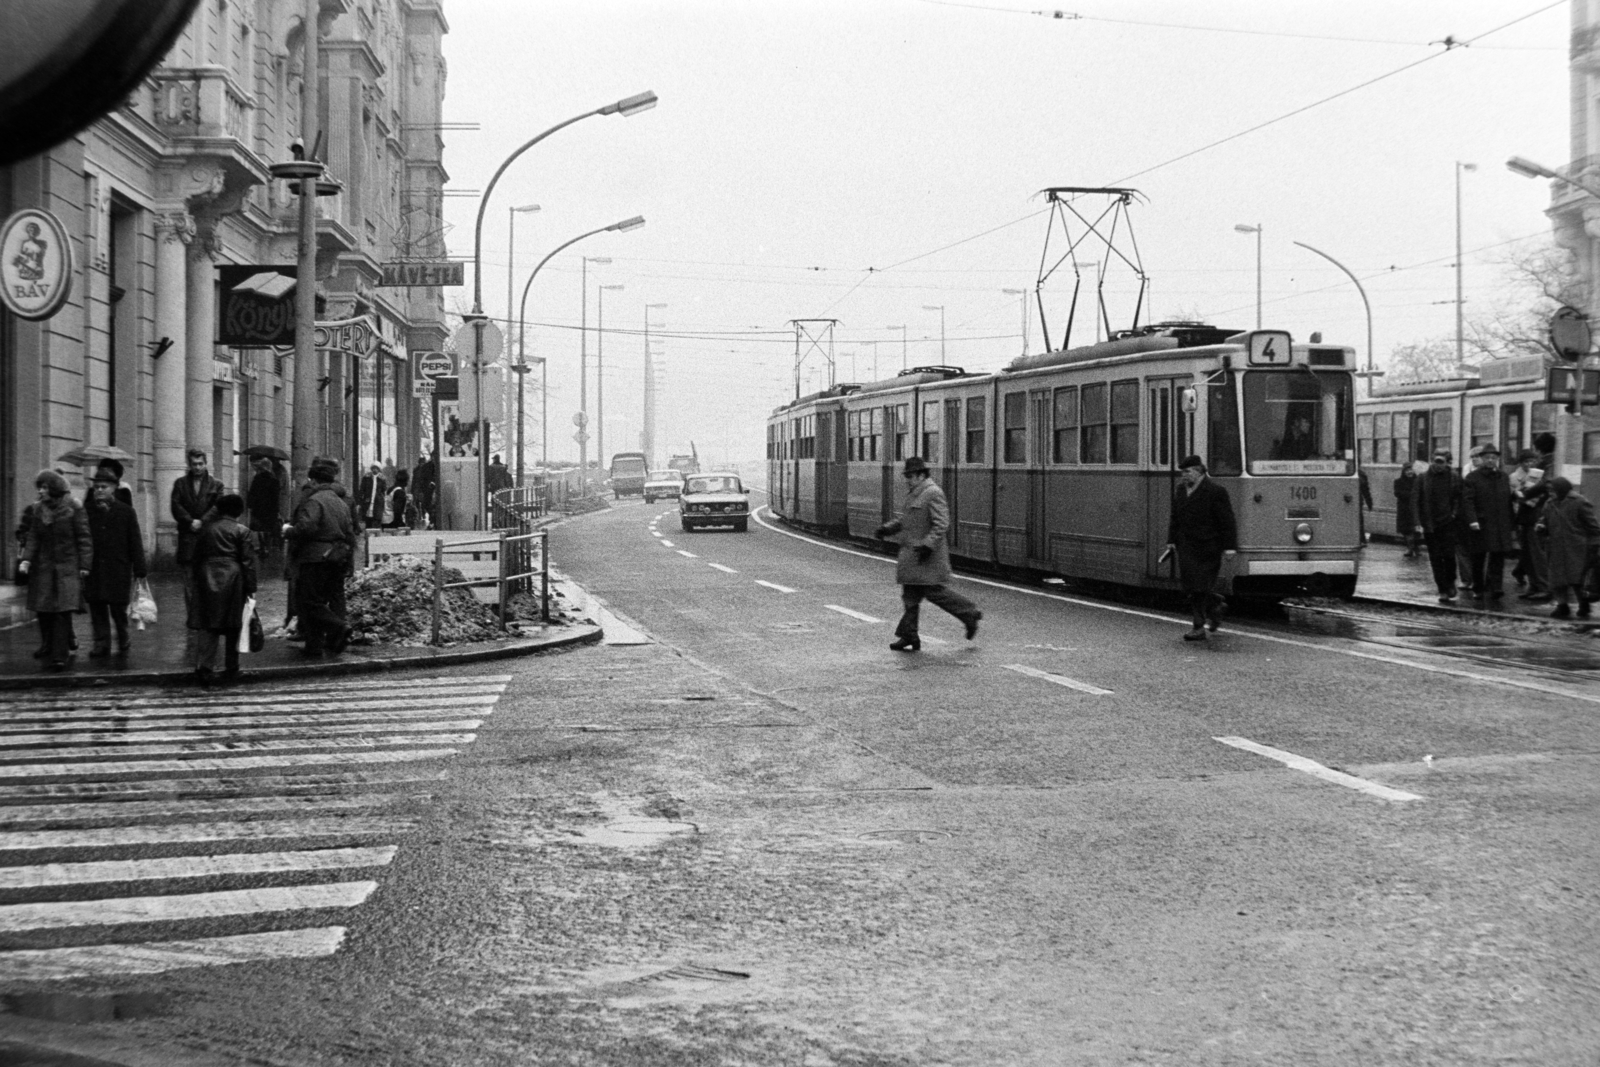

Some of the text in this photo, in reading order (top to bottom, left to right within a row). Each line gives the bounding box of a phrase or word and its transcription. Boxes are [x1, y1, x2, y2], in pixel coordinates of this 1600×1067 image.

[14, 281, 50, 298] BÁV
[1262, 337, 1275, 361] 4
[421, 362, 452, 371] PEPSI
[1290, 486, 1317, 500] 1400
